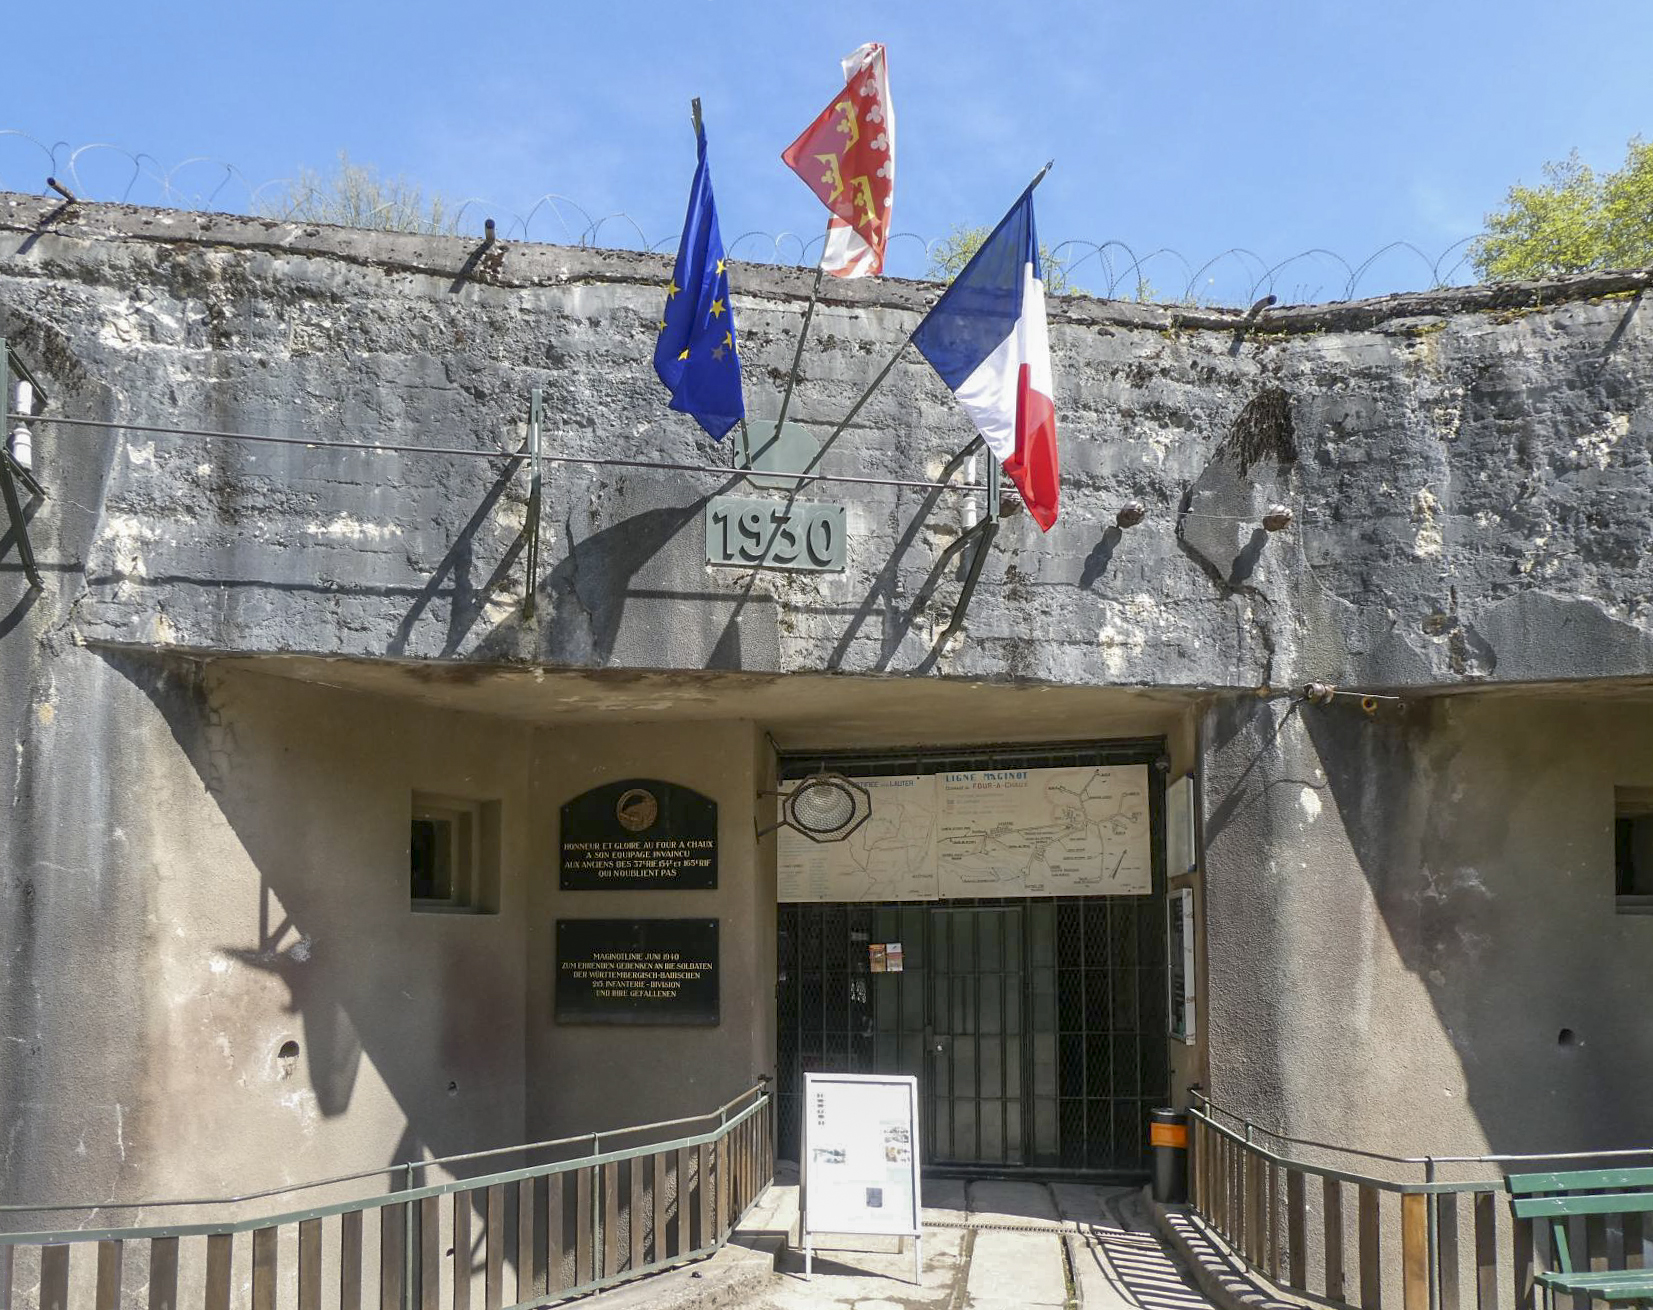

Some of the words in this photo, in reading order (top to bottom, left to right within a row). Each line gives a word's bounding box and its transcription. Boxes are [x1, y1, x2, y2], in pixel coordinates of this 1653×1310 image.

[711, 505, 836, 568] 1930
[946, 774, 977, 783] LIGNE
[984, 771, 1029, 780] MAGINOT
[563, 842, 600, 850] HONNEUR
[602, 842, 612, 850] ET
[613, 841, 641, 850] GLOIRE
[643, 841, 654, 849] AU
[655, 841, 677, 849] FOUR
[678, 841, 686, 849] A
[686, 840, 714, 848] CHAUX
[585, 851, 592, 859] A
[594, 851, 610, 859] SON
[611, 850, 651, 859] EQUIPAGE
[652, 850, 691, 858] INVAINCU
[564, 860, 580, 869] AUX
[581, 860, 614, 869] ANCIENS
[615, 860, 632, 868] DES
[698, 859, 712, 867] RIF
[597, 869, 612, 878] QUI
[660, 869, 677, 877] PAS
[592, 952, 643, 960] MAGINOTLINIE
[644, 952, 661, 960] JUNI
[662, 952, 680, 960] 1940
[561, 962, 577, 970] ZUM
[577, 962, 615, 970] EHRENDEN
[616, 962, 653, 970] GEDENKEN
[654, 962, 664, 970] AN
[664, 962, 676, 970] DIE
[676, 962, 713, 970] SOLDATEN
[573, 971, 588, 979] DER
[605, 980, 645, 988] INFANTERIE
[650, 980, 681, 988] DIVISION
[595, 989, 610, 997] UND
[629, 989, 677, 997] GEFALLENEN
